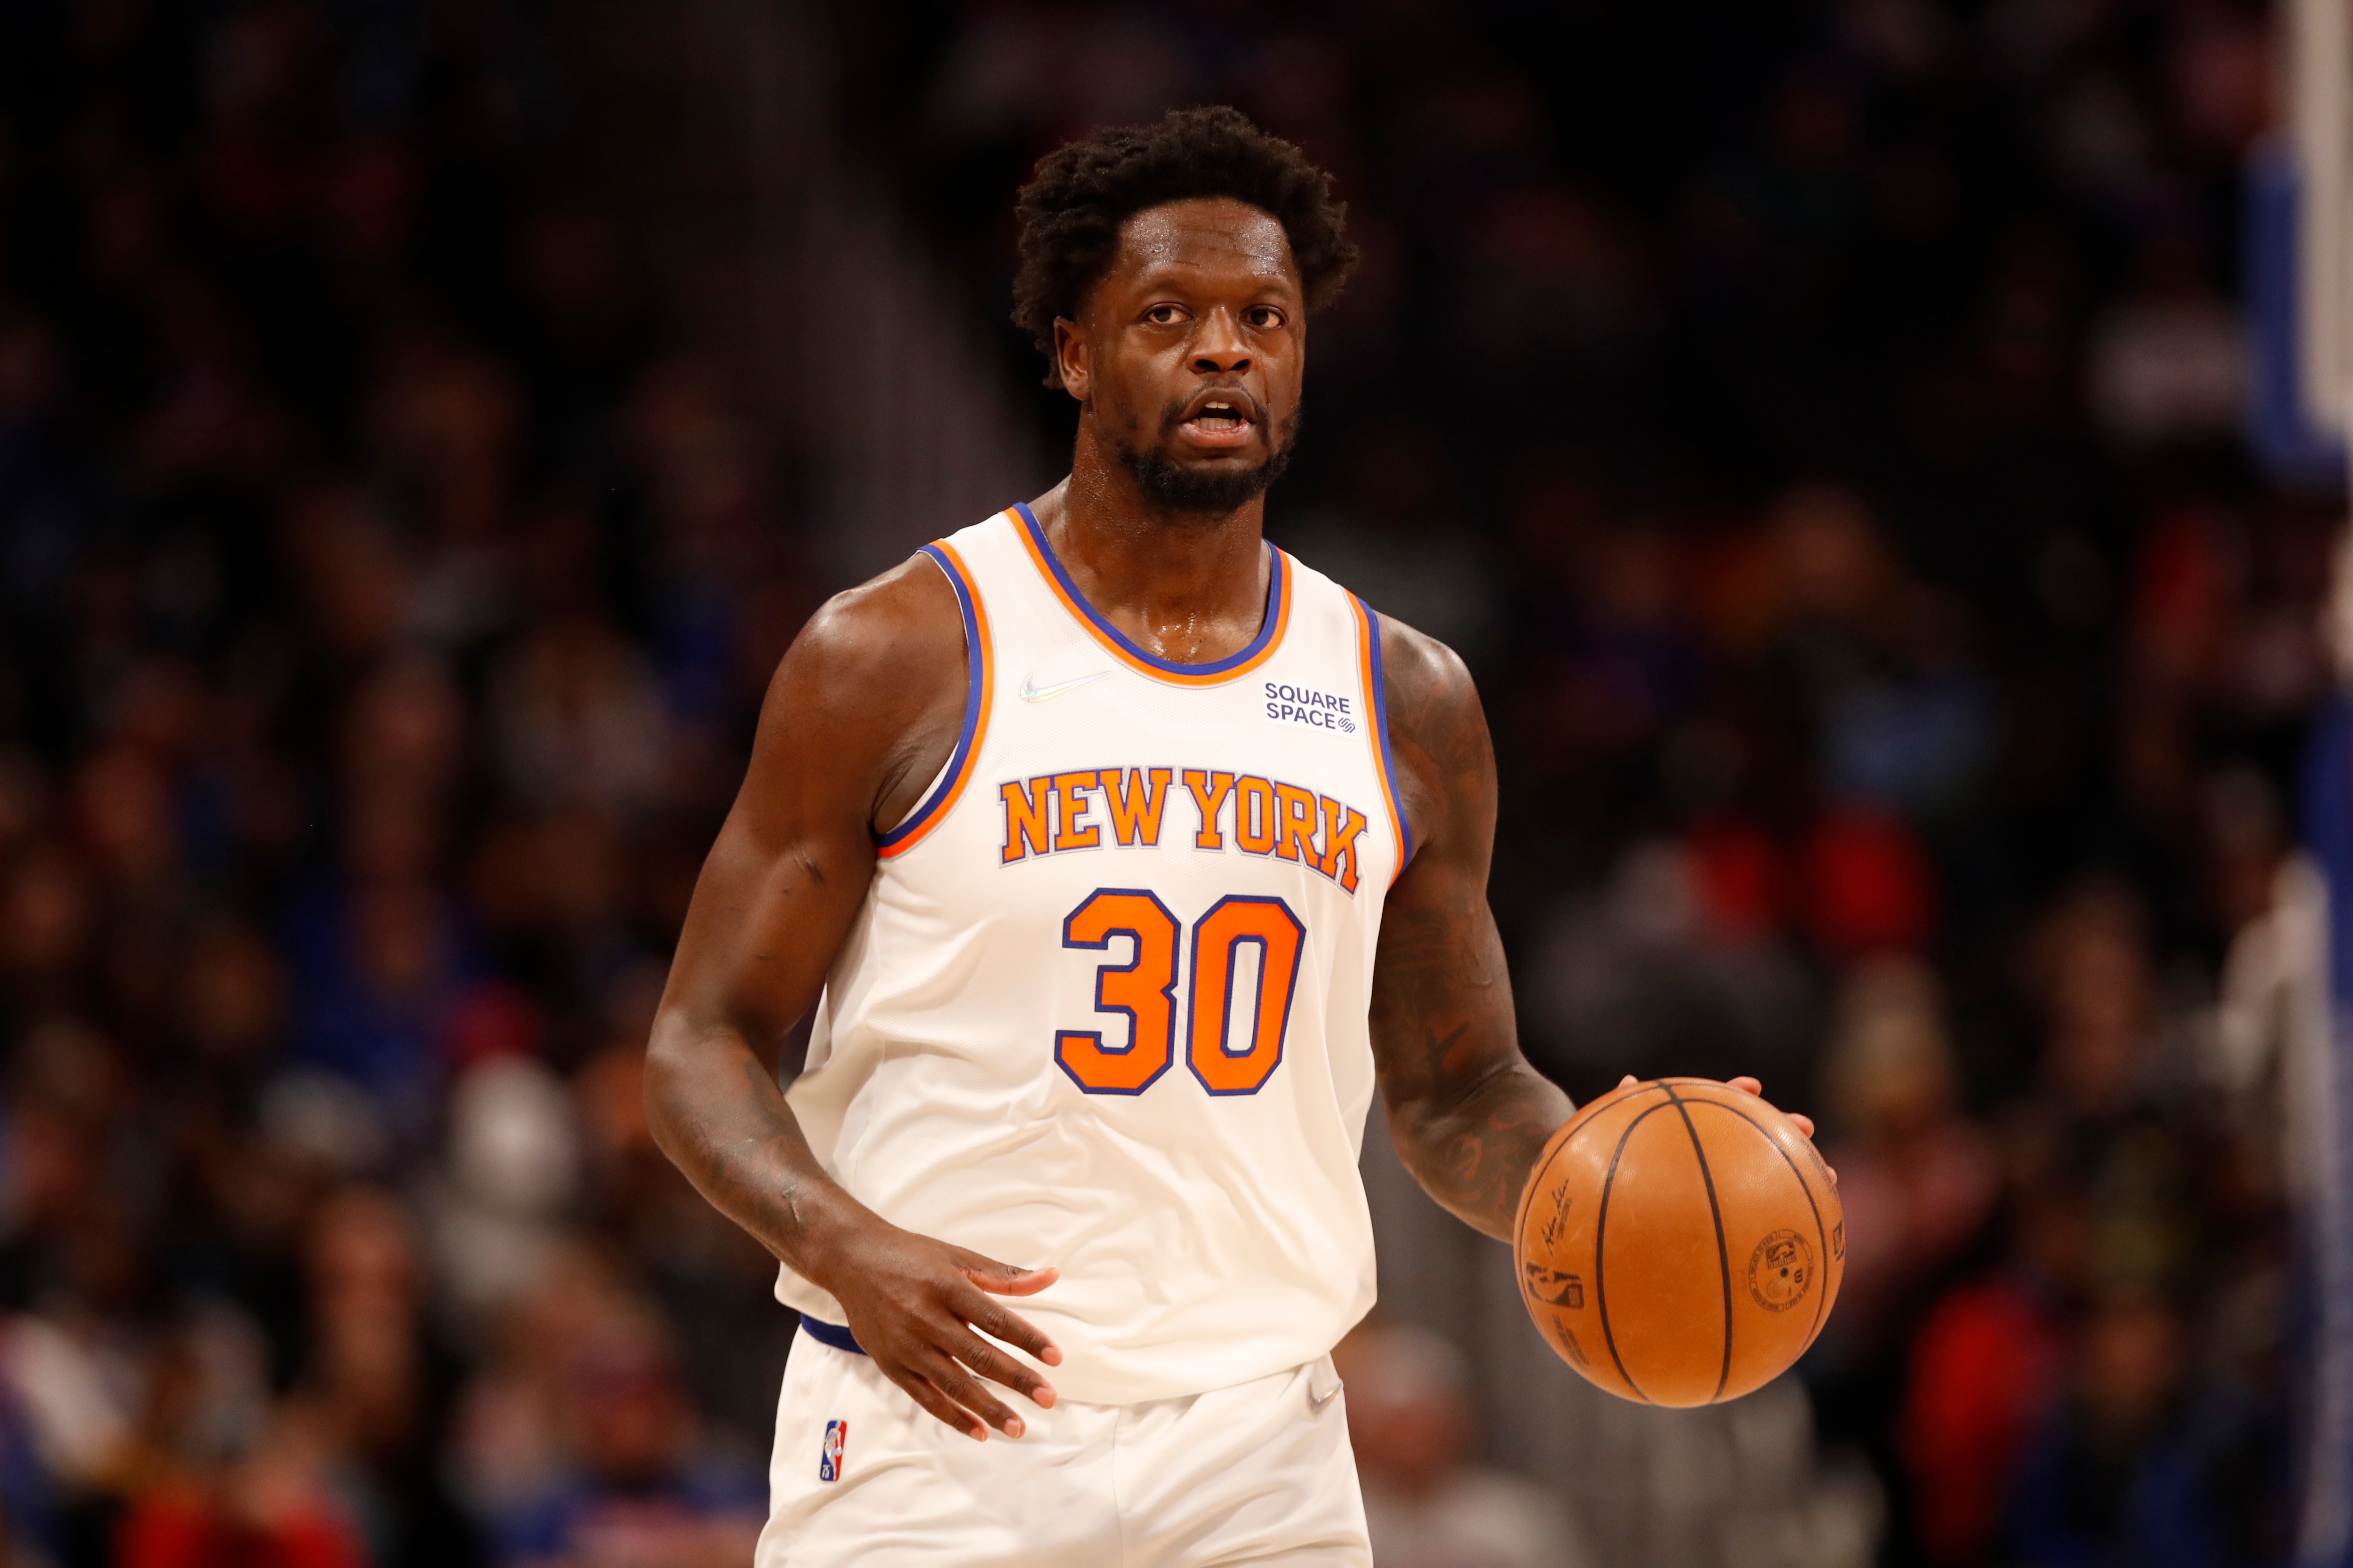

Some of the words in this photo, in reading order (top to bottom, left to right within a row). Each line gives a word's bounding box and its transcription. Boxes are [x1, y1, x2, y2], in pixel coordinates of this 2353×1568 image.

[1265, 682, 1351, 714] SQUARE
[1266, 703, 1336, 729] SPACE
[998, 767, 1173, 866] NEW
[1180, 767, 1368, 897] YORK
[1054, 887, 1306, 1097] 30
